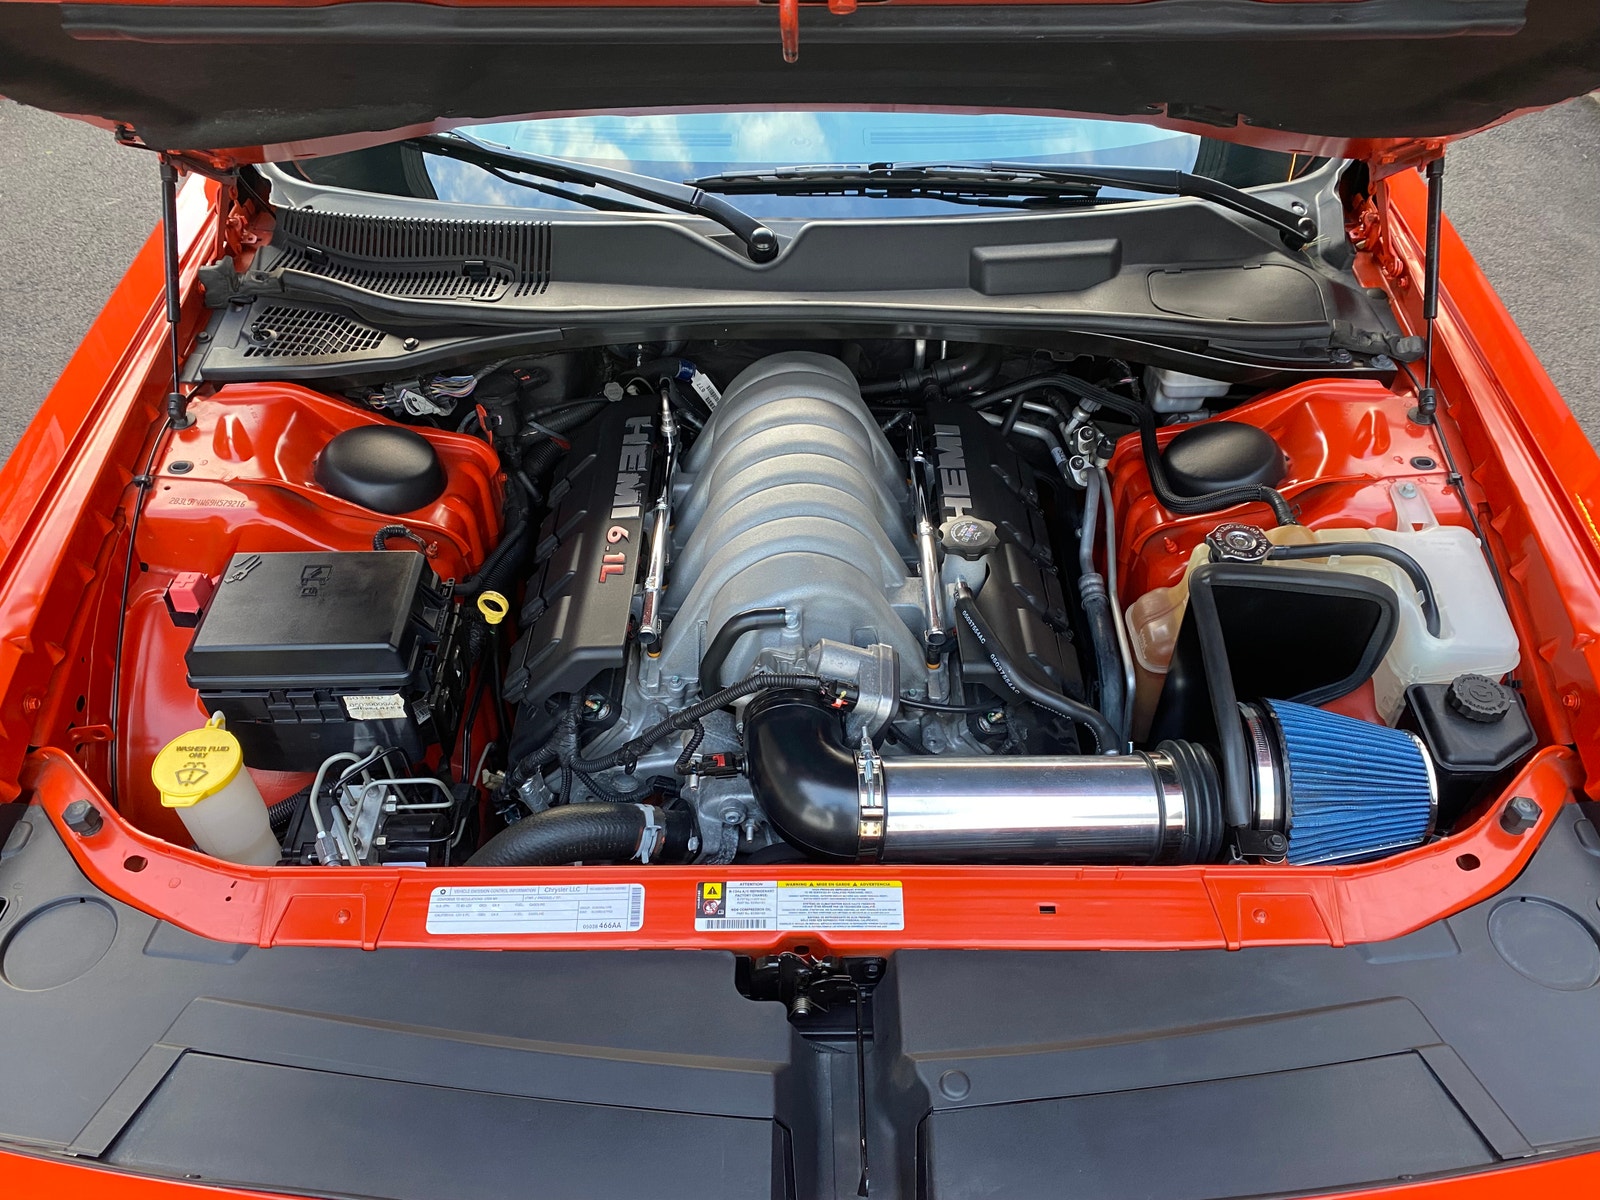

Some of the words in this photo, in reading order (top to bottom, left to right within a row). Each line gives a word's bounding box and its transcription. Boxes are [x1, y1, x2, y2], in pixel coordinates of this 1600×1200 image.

[610, 415, 653, 519] HEMI
[933, 424, 972, 522] HEMI
[598, 525, 630, 583] 6.1L
